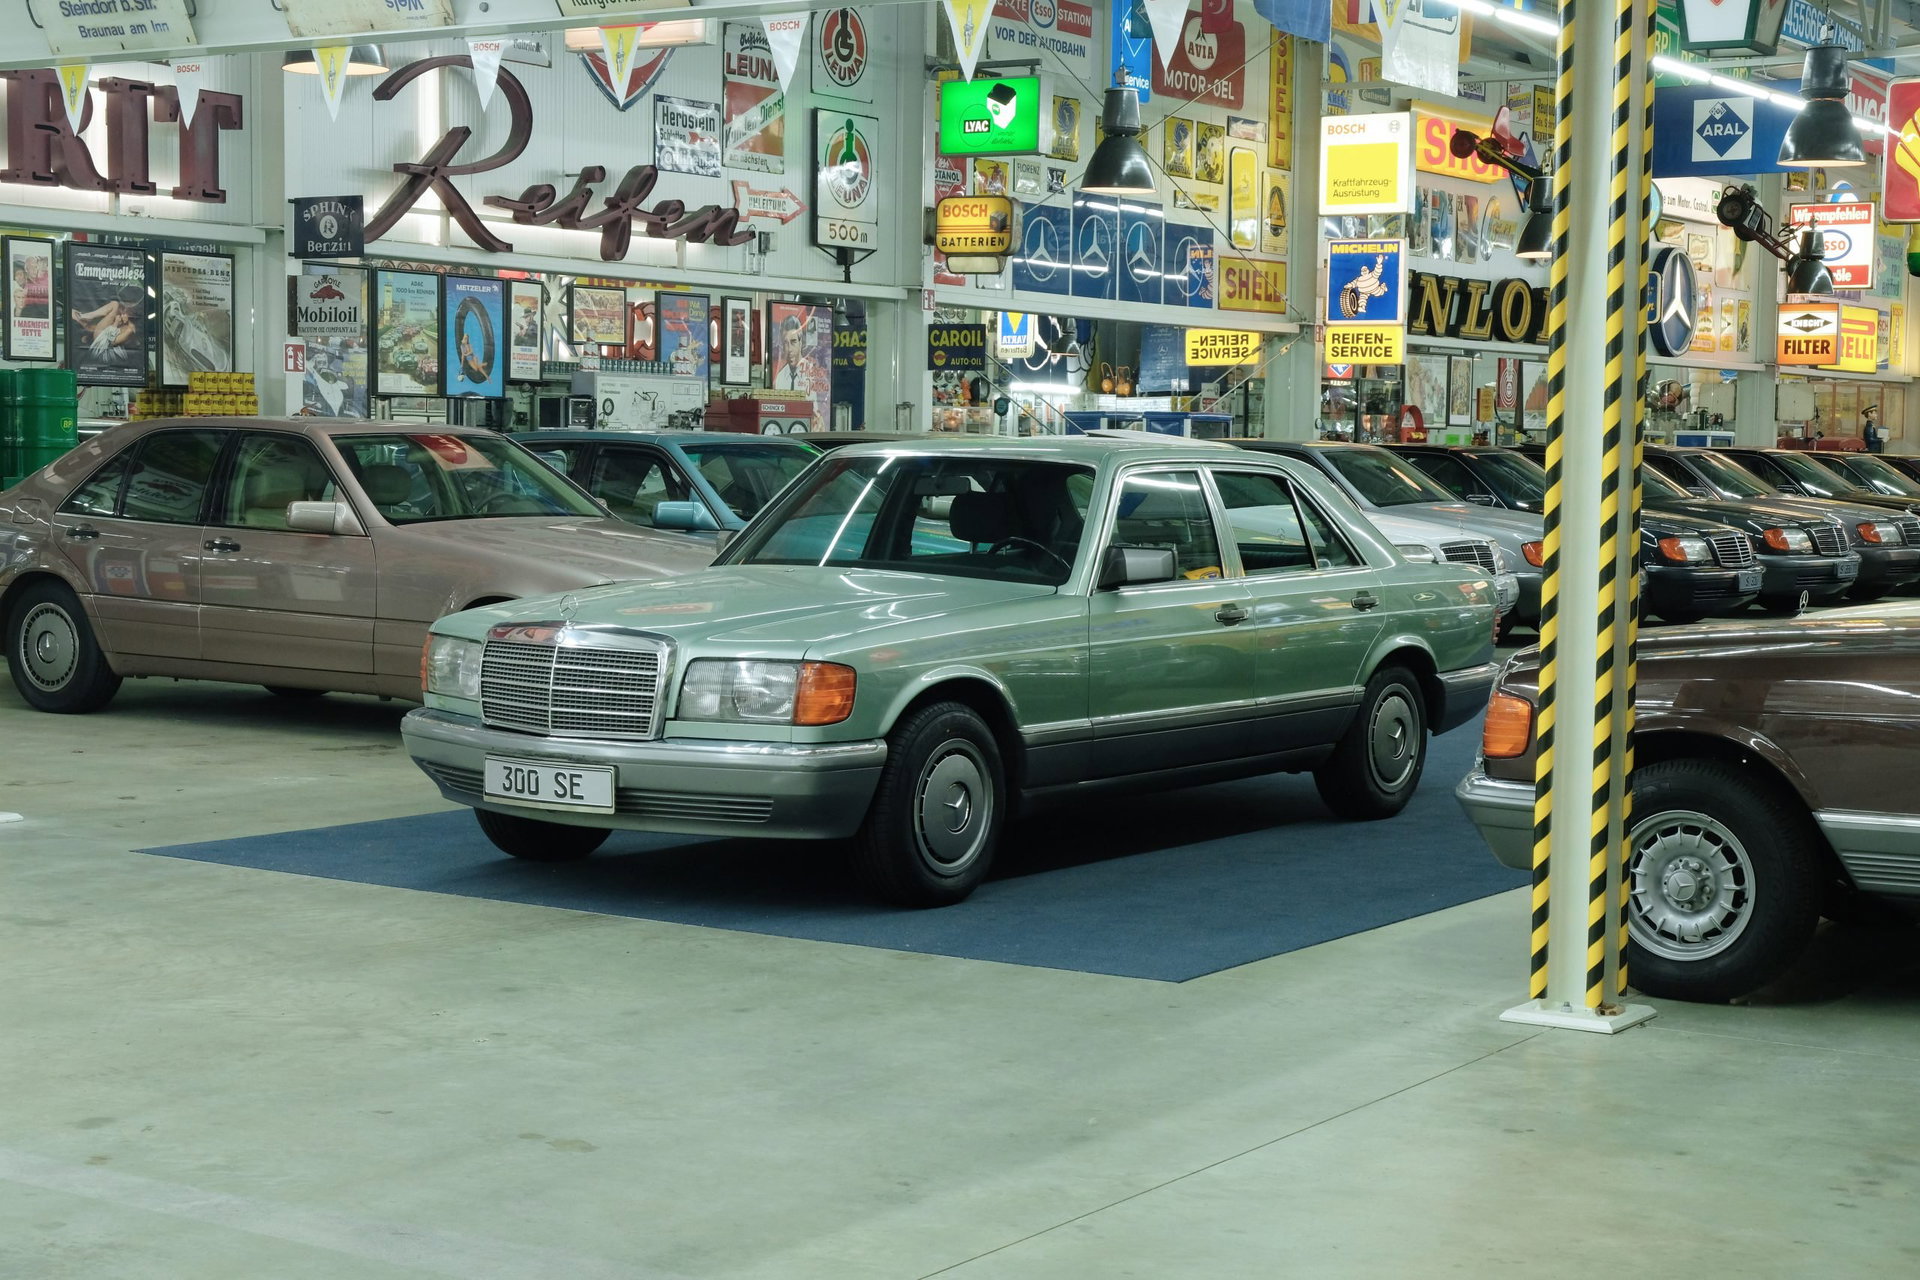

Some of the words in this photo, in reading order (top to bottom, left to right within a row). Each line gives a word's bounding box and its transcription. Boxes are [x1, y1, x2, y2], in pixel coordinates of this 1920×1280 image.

[770, 20, 800, 31] BOSCH
[1057, 8, 1091, 28] STATION
[79, 24, 125, 38] Braunau
[130, 24, 148, 35] am
[152, 20, 169, 33] Inn
[473, 42, 500, 51] BOSCH
[995, 25, 1015, 42] VOR
[1018, 32, 1036, 48] DER
[1039, 36, 1086, 59] AUTOBAHN
[1188, 43, 1215, 59] AVIA
[177, 64, 200, 73] BOSCH
[825, 52, 863, 81] LEUNA
[1164, 69, 1235, 100] MOTOR-OEL
[760, 92, 784, 124] Dienst
[964, 120, 990, 133] LYAC
[1327, 123, 1366, 135] BOSCH
[1702, 122, 1743, 137] ARAL
[363, 54, 757, 262] Reifen
[1332, 177, 1392, 188] Kraftfahrzeug-
[943, 204, 988, 218] BOSCH
[1793, 208, 1812, 221] Wir
[1813, 206, 1868, 224] empfehlen
[829, 222, 859, 242] 500
[861, 233, 868, 244] m
[307, 237, 352, 253] Benzin
[941, 236, 1005, 247] BATTERIEN
[1332, 243, 1398, 255] MICHELIN
[456, 284, 492, 293] METZELER
[1225, 267, 1282, 303] SHELL
[297, 306, 358, 323] Mobiloil
[1408, 268, 1550, 345] NLO
[929, 329, 984, 348] CAROIL
[1331, 346, 1393, 358] SERVICE
[1784, 339, 1831, 355] FILTER
[950, 357, 983, 366] AUTO-OIL
[502, 765, 539, 796] 300
[553, 771, 585, 801] SE
